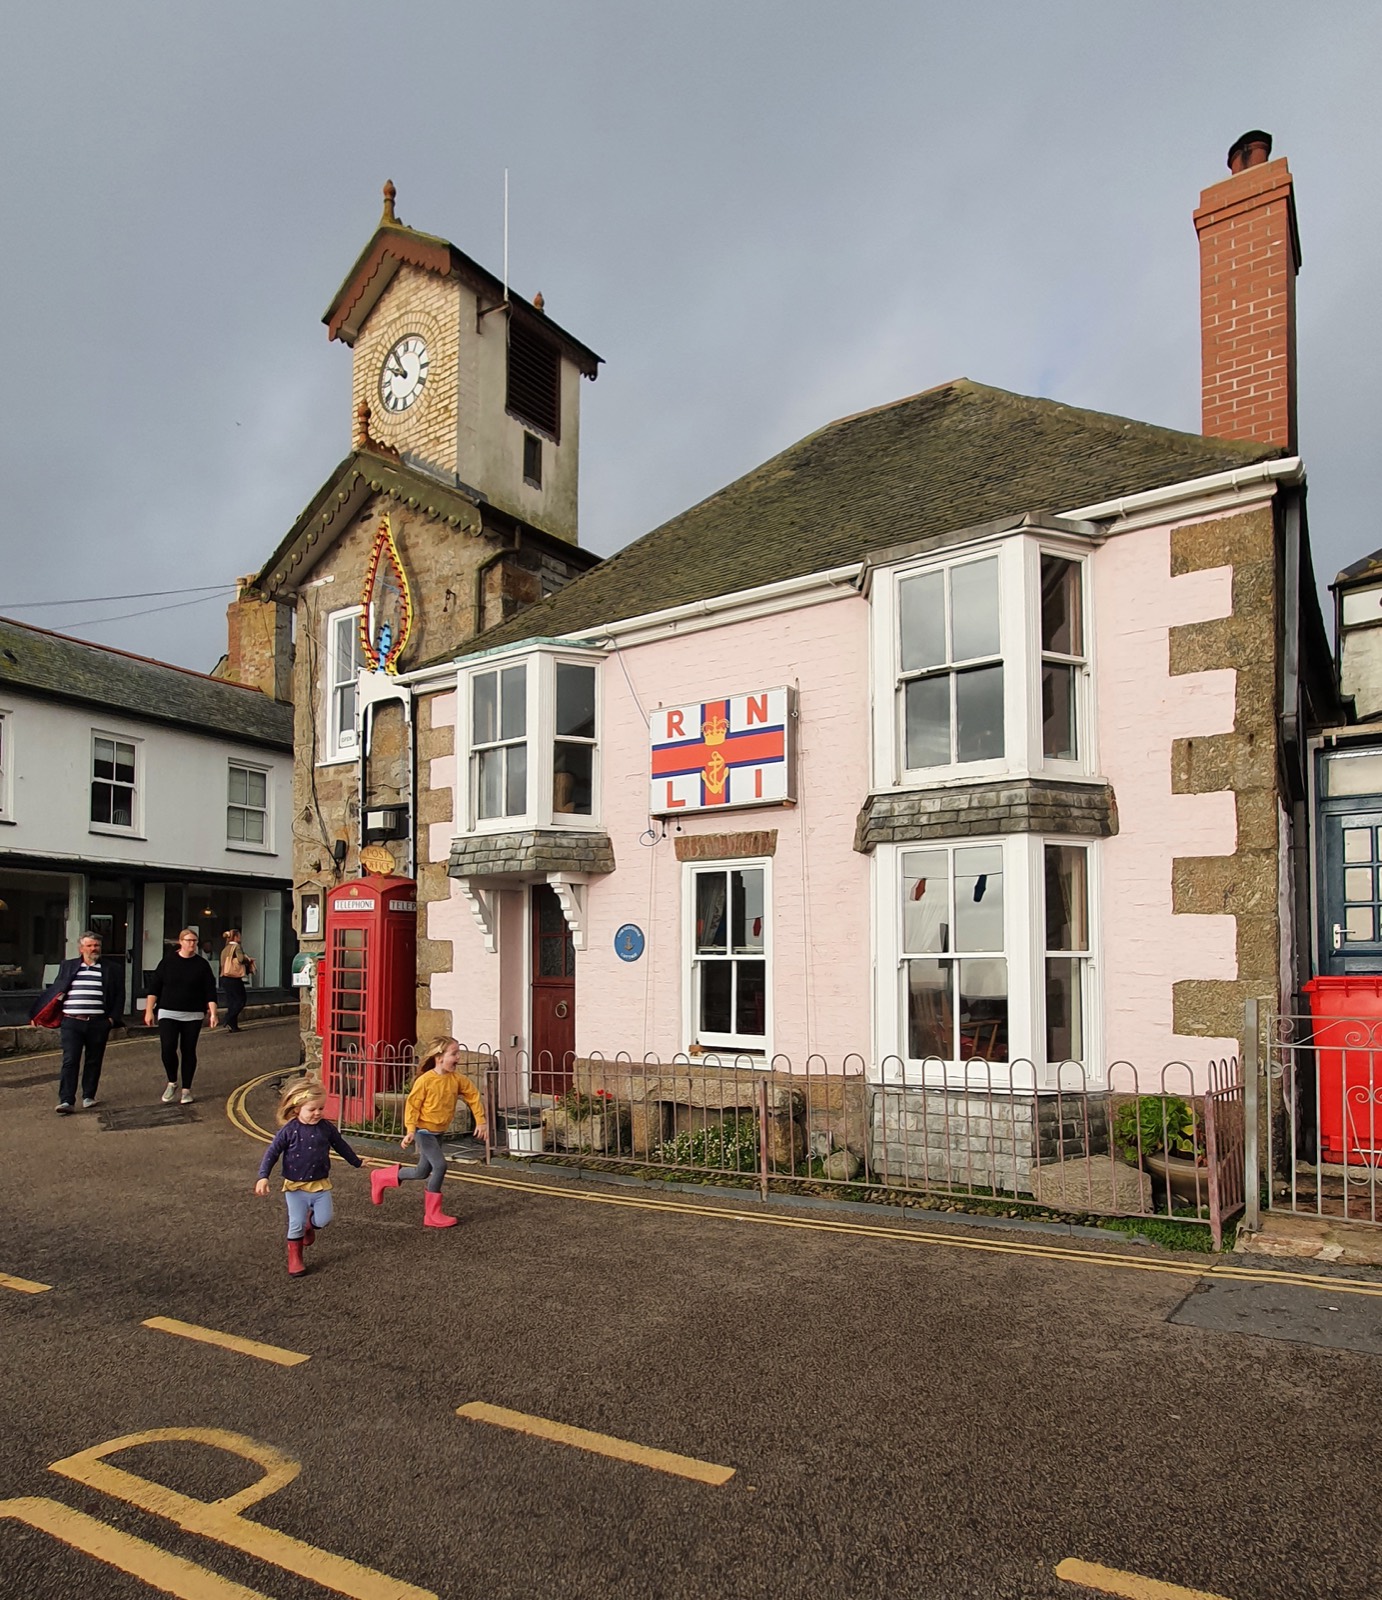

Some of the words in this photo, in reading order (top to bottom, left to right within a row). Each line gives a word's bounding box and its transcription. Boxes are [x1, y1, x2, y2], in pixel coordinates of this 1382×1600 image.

[667, 710, 686, 738] R
[747, 694, 768, 725] N
[667, 781, 686, 808] L
[755, 769, 762, 798] I
[366, 849, 388, 860] POST
[366, 860, 390, 871] OFFICE
[336, 900, 373, 909] TELEPHONE
